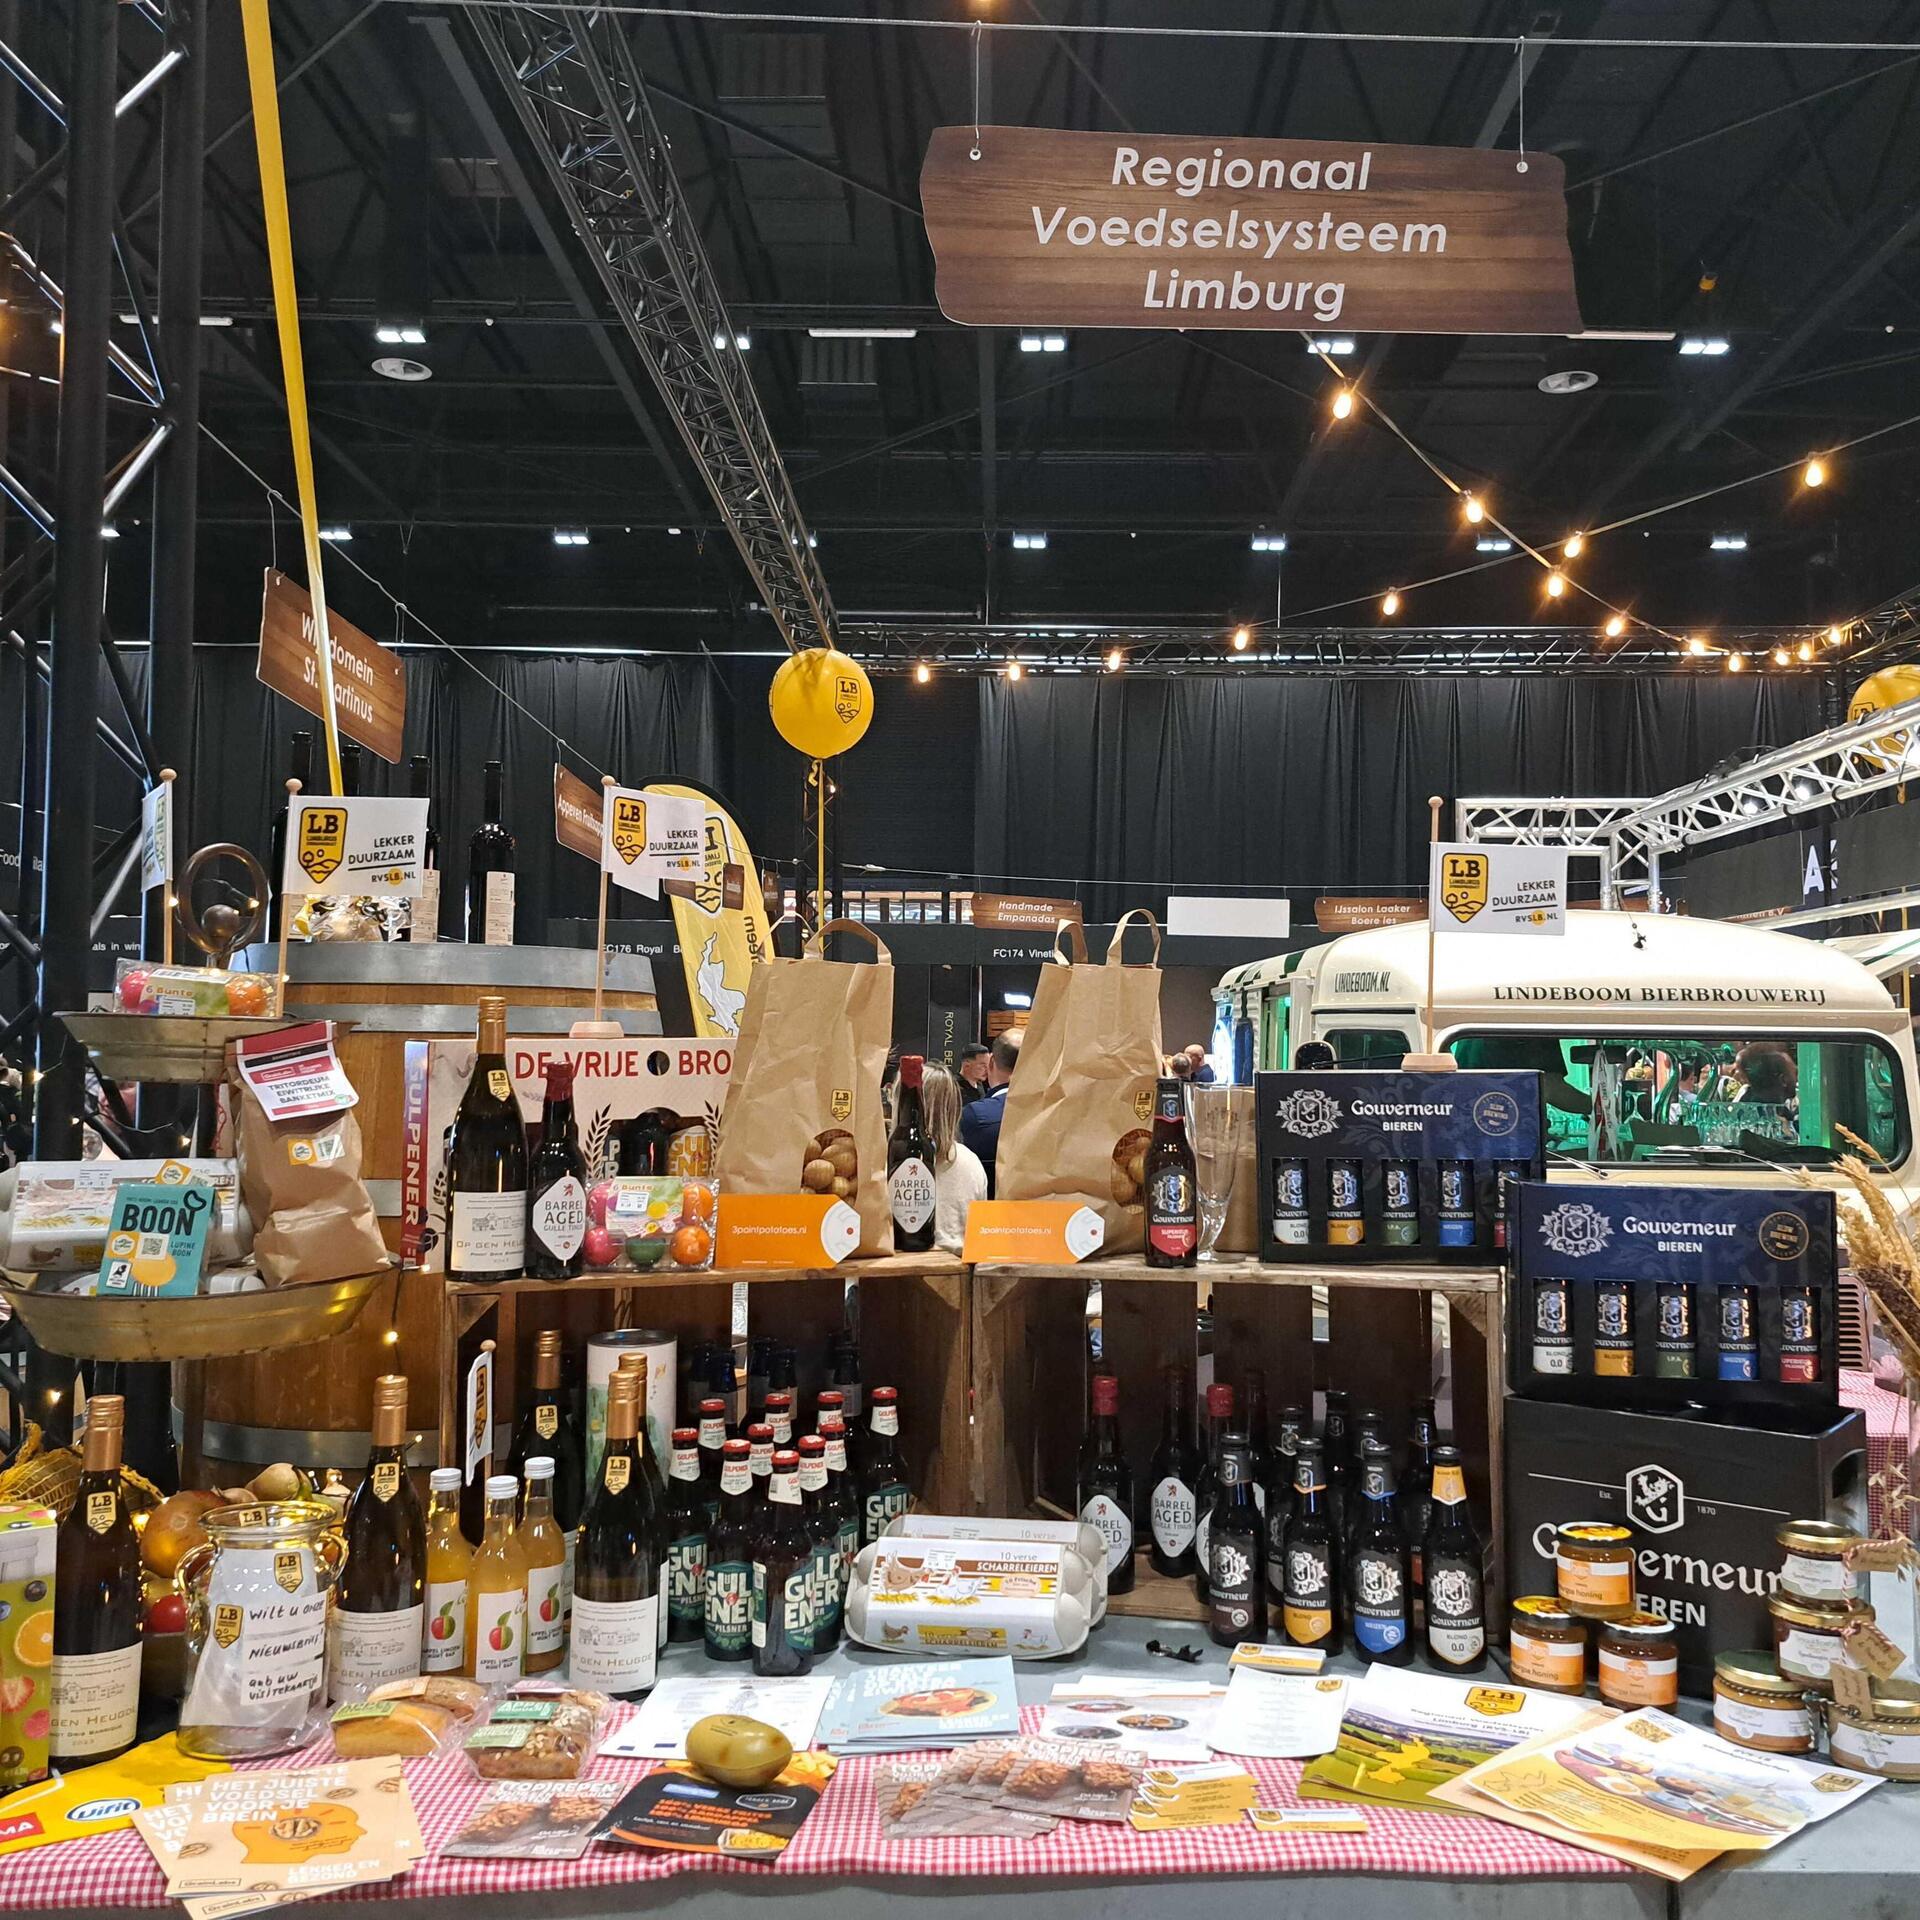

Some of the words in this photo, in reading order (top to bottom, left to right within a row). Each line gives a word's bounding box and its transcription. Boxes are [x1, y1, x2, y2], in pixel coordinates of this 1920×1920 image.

[1111, 147, 1372, 198] Regionaal
[1031, 205, 1448, 259] Voedselsysteem
[1143, 268, 1346, 323] Limburg
[839, 680, 859, 694] LB
[618, 803, 641, 823] LB
[307, 814, 339, 834] LB
[666, 829, 699, 839] LEKKER
[373, 835, 415, 848] LEKKER
[649, 841, 699, 851] DUURZAAM
[348, 849, 415, 865] DUURZAAM
[1449, 859, 1481, 878] LB
[1516, 880, 1556, 892] LEKKER
[1492, 893, 1557, 907] DUURZAAM
[998, 901, 1053, 914] Handmade
[1335, 904, 1374, 914] IJssalon
[1376, 904, 1411, 914] Laaker
[996, 911, 1056, 925] Empanadas
[1351, 916, 1380, 925] Boere
[1515, 913, 1558, 923] RVSLB.NL
[636, 944, 663, 954] Royal
[993, 948, 1024, 959] FC174
[1334, 971, 1391, 993] LINDEBOOM.NL
[1493, 985, 1631, 1003] LINDEBOOM
[1640, 985, 1826, 1007] BIERBROUWERIJ
[944, 1010, 954, 1047] ROYAL
[491, 1072, 508, 1082] LB
[834, 1091, 849, 1101] LB
[1350, 1099, 1453, 1117] Gouverneur
[1382, 1121, 1423, 1132] BIEREN
[894, 1179, 931, 1189] BARREL
[894, 1188, 931, 1201] AGED
[544, 1199, 584, 1211] BARREL
[120, 1203, 195, 1236] BOON
[544, 1211, 584, 1225] AGED
[731, 1225, 807, 1236] 3pointpotatoes.nl
[1622, 1216, 1737, 1236] Gouverneur
[170, 1240, 195, 1249] LUPINE
[1657, 1241, 1703, 1253] BIEREN
[539, 1408, 555, 1417] LB
[610, 1459, 627, 1470] LB
[377, 1466, 396, 1477] LB
[1598, 1489, 1612, 1500] Est.
[91, 1495, 113, 1507] LB
[1154, 1499, 1192, 1510] BARREL
[1697, 1505, 1716, 1516] 1870
[242, 1511, 263, 1523] LB
[1154, 1511, 1192, 1524] AGED
[278, 1555, 297, 1568] LB
[1000, 1552, 1010, 1561] 10
[1012, 1553, 1038, 1561] verse
[976, 1561, 1057, 1573] SCHARRELEIEREN
[219, 1607, 238, 1620] LB
[1431, 1615, 1480, 1627] Gouverneur
[714, 1624, 748, 1633] PILSNER
[1480, 1688, 1516, 1701] LB
[213, 1778, 258, 1791] HET
[264, 1776, 347, 1790] JUISTE
[210, 1788, 319, 1801] VOEDSEL
[206, 1800, 273, 1812] VOOR
[280, 1798, 311, 1810] JE
[202, 1810, 278, 1824] BREIN
[357, 1859, 380, 1869] EN
